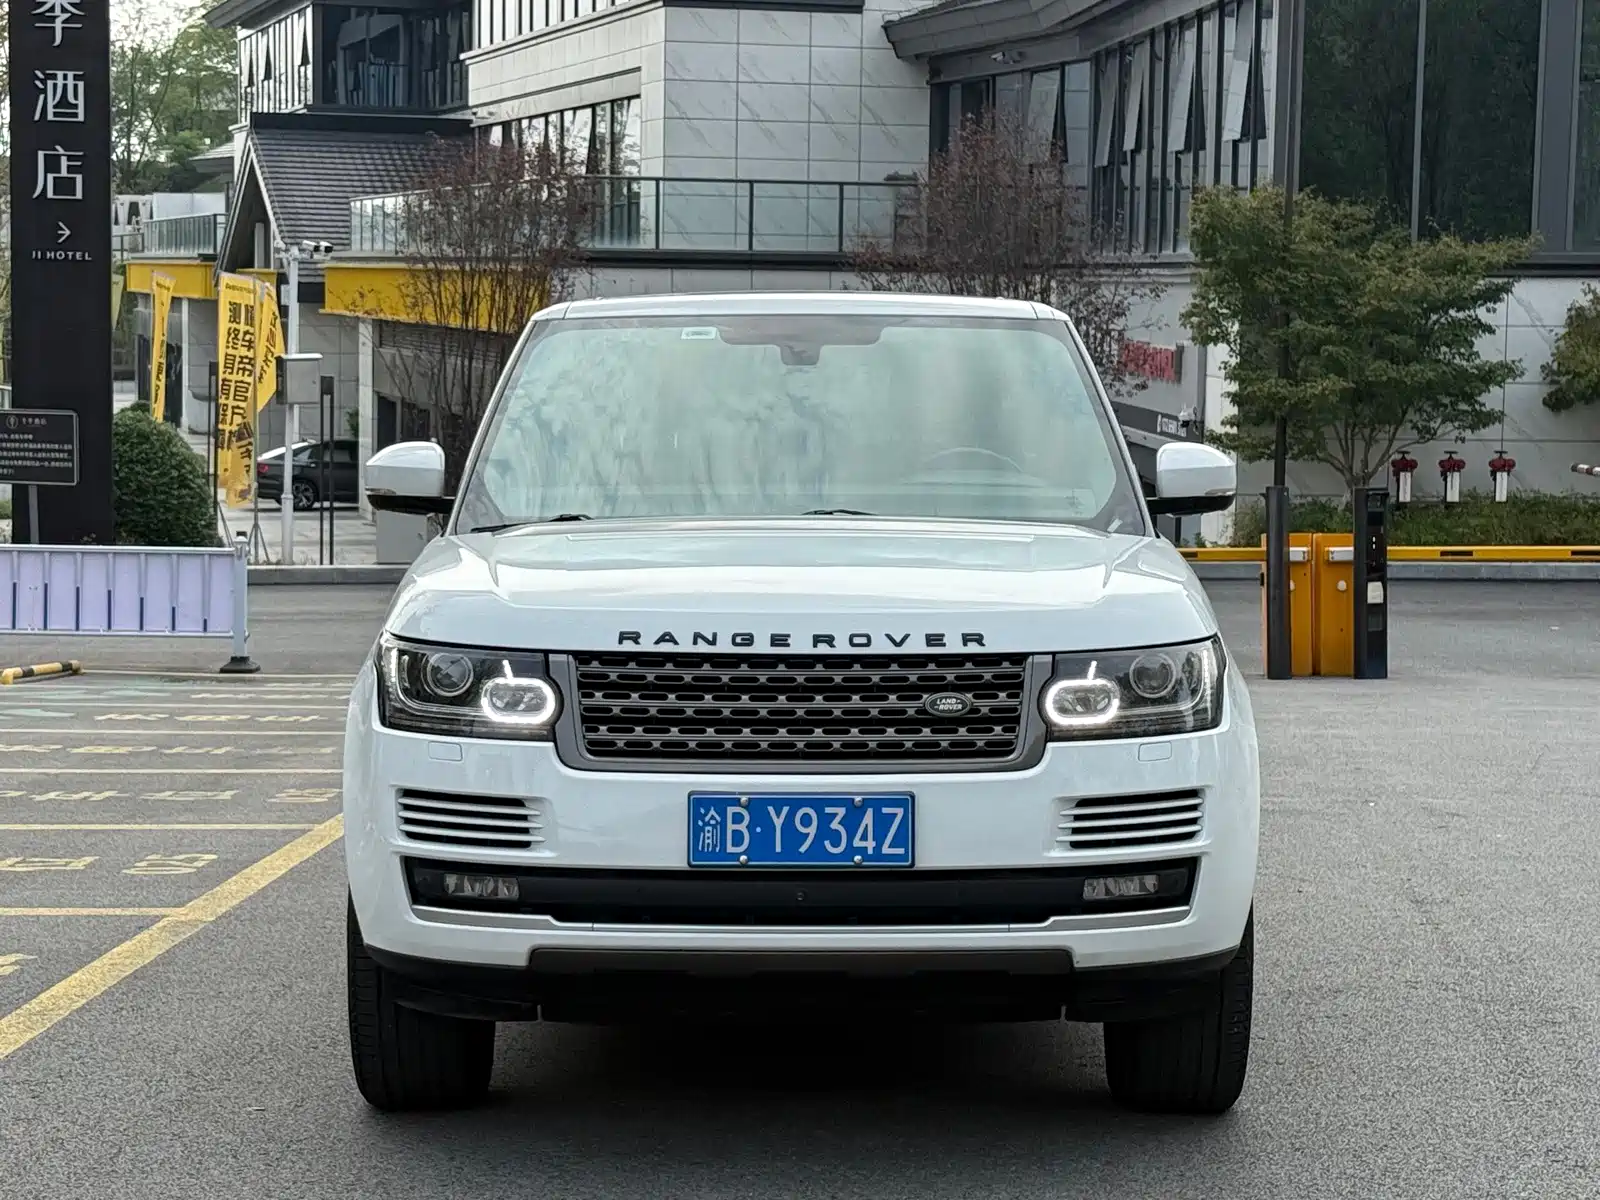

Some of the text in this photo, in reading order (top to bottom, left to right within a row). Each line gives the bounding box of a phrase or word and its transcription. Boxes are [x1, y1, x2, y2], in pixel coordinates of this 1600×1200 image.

[46, 250, 93, 261] HOTEL
[617, 630, 987, 649] RANGE ROVER
[939, 703, 963, 711] ROVER
